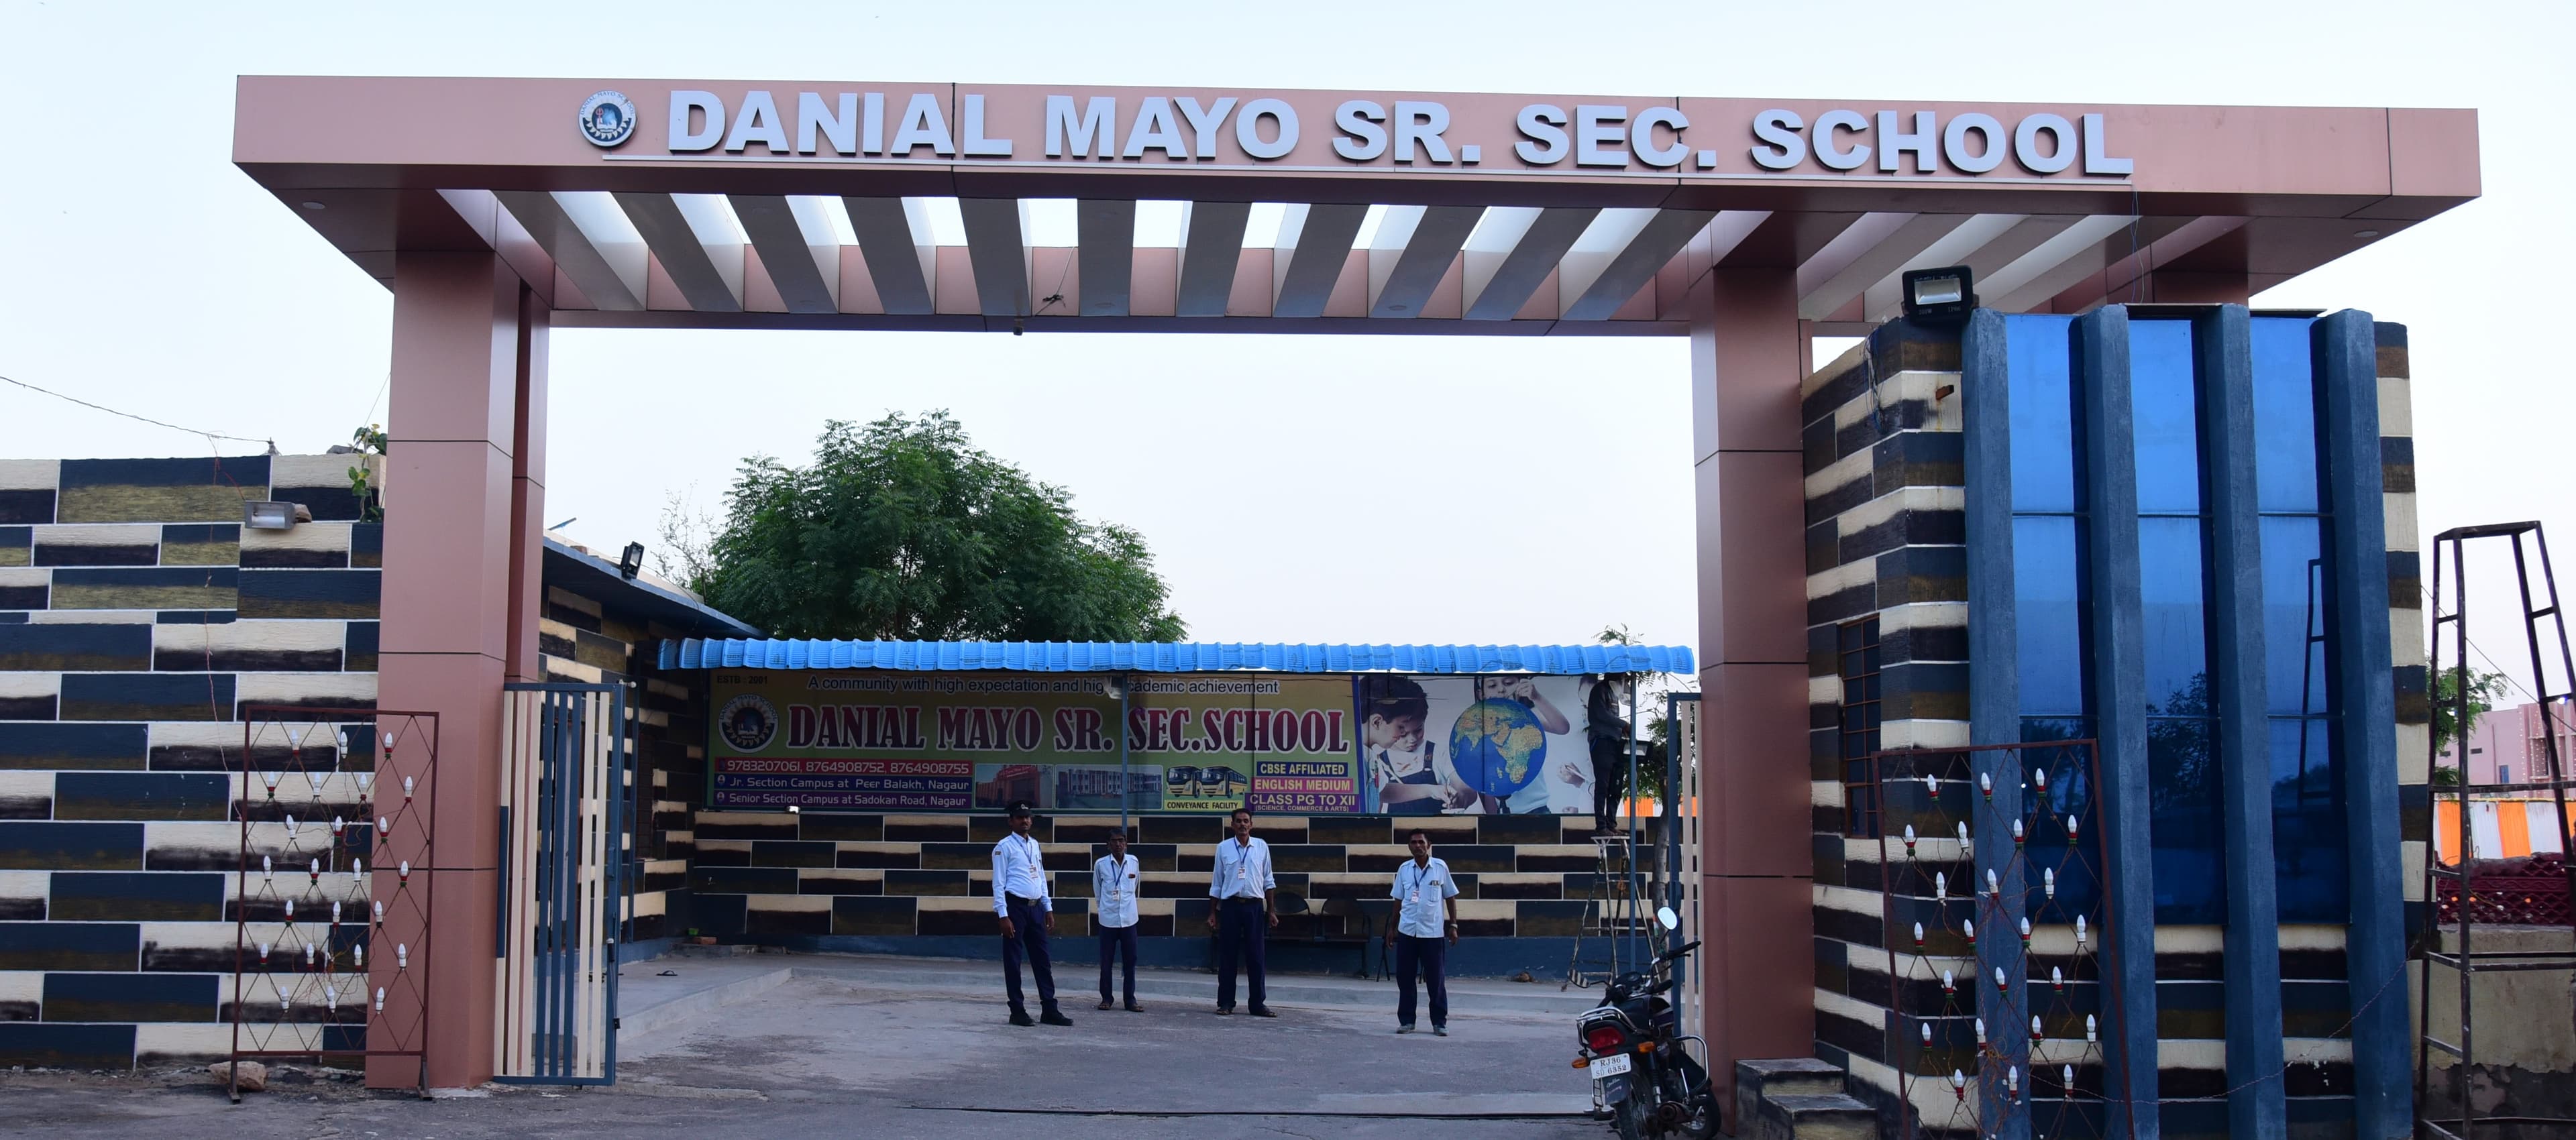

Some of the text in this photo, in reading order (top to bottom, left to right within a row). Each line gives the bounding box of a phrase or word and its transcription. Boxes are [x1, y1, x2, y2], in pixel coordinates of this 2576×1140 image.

[617, 94, 634, 115] SCOOL
[669, 89, 2133, 176] DANIAL MAYO SR. SEC. SCHOOL
[716, 675, 741, 684] ESTB
[748, 675, 768, 685] 2001
[808, 676, 1279, 695] A community with high expectation and hig cademic achievement
[787, 704, 926, 750] DANIAL
[937, 705, 1042, 752] MAYO
[1053, 707, 1115, 753] SR.
[727, 760, 969, 774] 9783207061, 8764908752, 8764908755
[1260, 764, 1345, 775] CBSE AFFILIATED
[730, 777, 969, 793] Jr. Section Campus at Peer Balakh, Nagaur
[1254, 779, 1350, 791] ENGLISH MEDIUM
[729, 793, 967, 808] Senior Section Campus at Sadokan Road, Nagaur
[1167, 801, 1238, 810] CONVEYANCE FACILITY
[1249, 794, 1355, 806] CLASS PG TO XII
